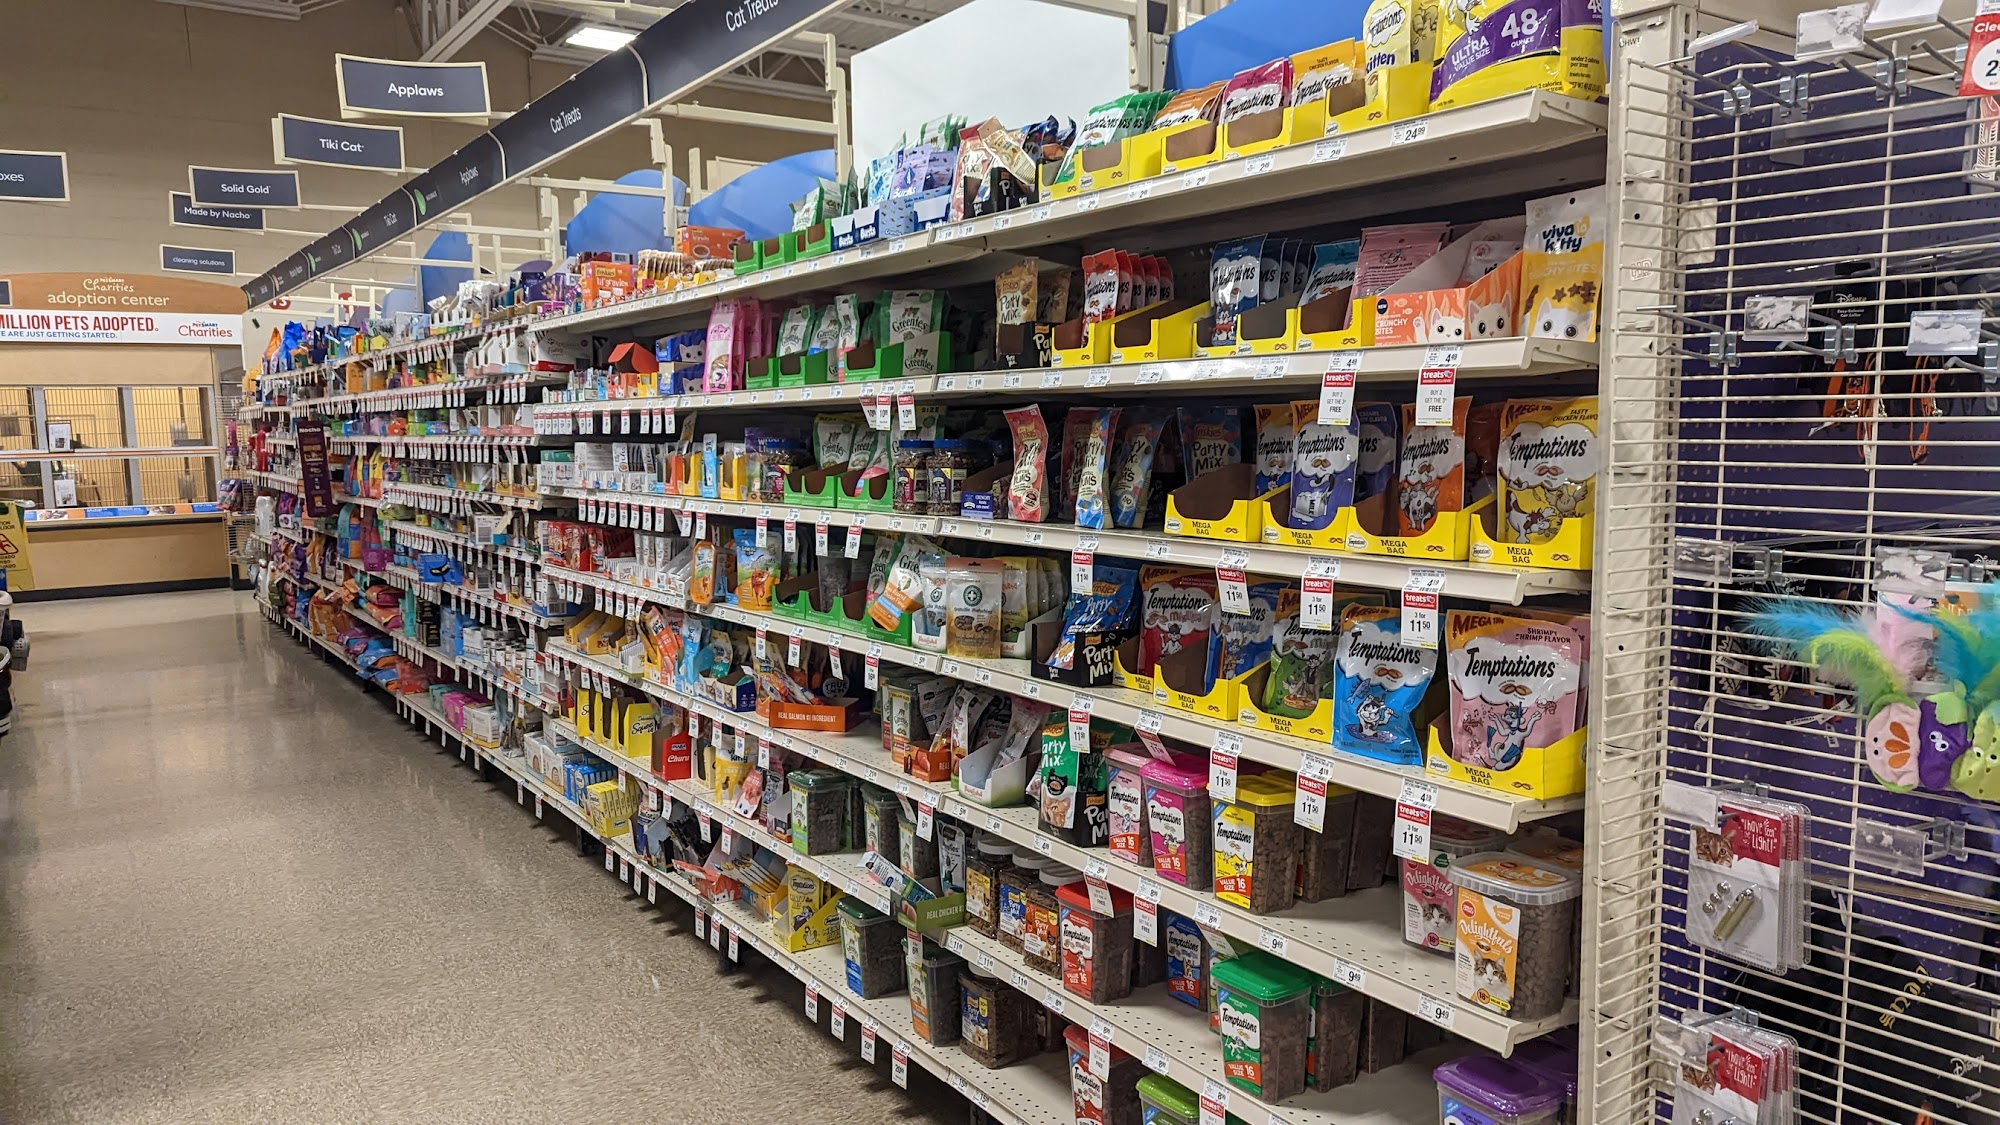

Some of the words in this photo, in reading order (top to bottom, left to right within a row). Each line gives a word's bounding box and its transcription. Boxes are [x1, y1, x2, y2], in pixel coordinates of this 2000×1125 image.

[726, 9, 746, 31] Cat
[744, 0, 779, 20] Treats
[1501, 9, 1538, 39] 48
[1510, 37, 1534, 48] OUNCE
[1451, 36, 1489, 66] ULTRA
[1454, 55, 1475, 72] VALUE
[1474, 48, 1490, 65] SIZE
[388, 83, 444, 97] Applaws
[550, 116, 563, 133] Cat
[561, 107, 581, 128] Treats
[319, 138, 339, 150] Tiki
[340, 140, 363, 152] Cat
[460, 166, 478, 185] Applaws
[220, 183, 243, 194] Solid
[244, 184, 270, 195] Gold
[184, 206, 208, 216] Made
[209, 209, 222, 219] by
[222, 210, 252, 220] Nacho
[1543, 223, 1575, 240] viva
[1544, 236, 1583, 253] kitty
[172, 256, 198, 267] cleaning
[199, 257, 225, 266] solutions
[83, 278, 134, 293] Charities
[48, 291, 118, 307] adoption
[121, 294, 170, 306] center
[0, 314, 50, 330] MILLION
[55, 316, 89, 331] PETS
[93, 317, 159, 332] ADOPTED.
[891, 316, 928, 333] Greenies
[1376, 319, 1408, 328] CRUNCHY
[178, 325, 233, 338] Charities
[1376, 327, 1394, 335] BITES
[904, 357, 935, 371] Greenies
[1423, 371, 1444, 379] treats
[1506, 404, 1540, 427] MEGA
[1192, 442, 1228, 459] Party
[1296, 431, 1346, 463] Temptations
[1510, 433, 1588, 468] Temptations
[1195, 458, 1222, 473] Mix
[1192, 521, 1211, 529] MEGA
[1196, 527, 1210, 535] BAG
[1291, 531, 1313, 540] MEGA
[1296, 538, 1312, 546] BAG
[1381, 539, 1407, 548] MEGA
[1386, 546, 1405, 555] BAG
[1507, 546, 1533, 556] MEGA
[1511, 555, 1531, 564] BAG
[1146, 588, 1209, 615] Temptations
[1405, 594, 1426, 602] treats
[1085, 597, 1113, 613] Party
[1453, 614, 1492, 639] MEGA
[1544, 635, 1571, 644] FLAVOR
[1348, 631, 1420, 666] Temptations
[1464, 647, 1556, 684] Temptations
[1089, 662, 1114, 684] Mix
[1178, 694, 1196, 704] MEGA
[1181, 702, 1194, 710] BAG
[812, 714, 836, 722] INGREDIENT
[1270, 717, 1293, 727] MEGA
[1275, 724, 1290, 733] BAG
[1213, 754, 1230, 762] treats
[1465, 767, 1492, 779] MEGA
[1299, 779, 1317, 789] treats
[1471, 775, 1490, 785] BAG
[1110, 786, 1138, 805] Temptations
[1150, 805, 1182, 826] Temptations
[1399, 805, 1420, 817] treats
[1216, 822, 1252, 844] Temptations
[1127, 836, 1135, 846] 16
[1173, 858, 1180, 868] 16
[1219, 878, 1236, 886] VALUE
[1237, 877, 1246, 890] 16
[1406, 871, 1454, 896] Delightfuls
[927, 910, 939, 919] REAL
[940, 907, 958, 918] CHICKEN
[1063, 924, 1090, 943] Temptations
[1459, 919, 1513, 954] Delightfuls
[1168, 931, 1199, 951] Temptations
[1079, 971, 1087, 983] 16
[1186, 980, 1194, 991] 16
[1222, 1008, 1257, 1032] Temptations
[1232, 1069, 1244, 1077] SIZE
[1246, 1064, 1254, 1076] 16
[1075, 1067, 1101, 1093] Temptations
[1202, 1099, 1217, 1110] treats
